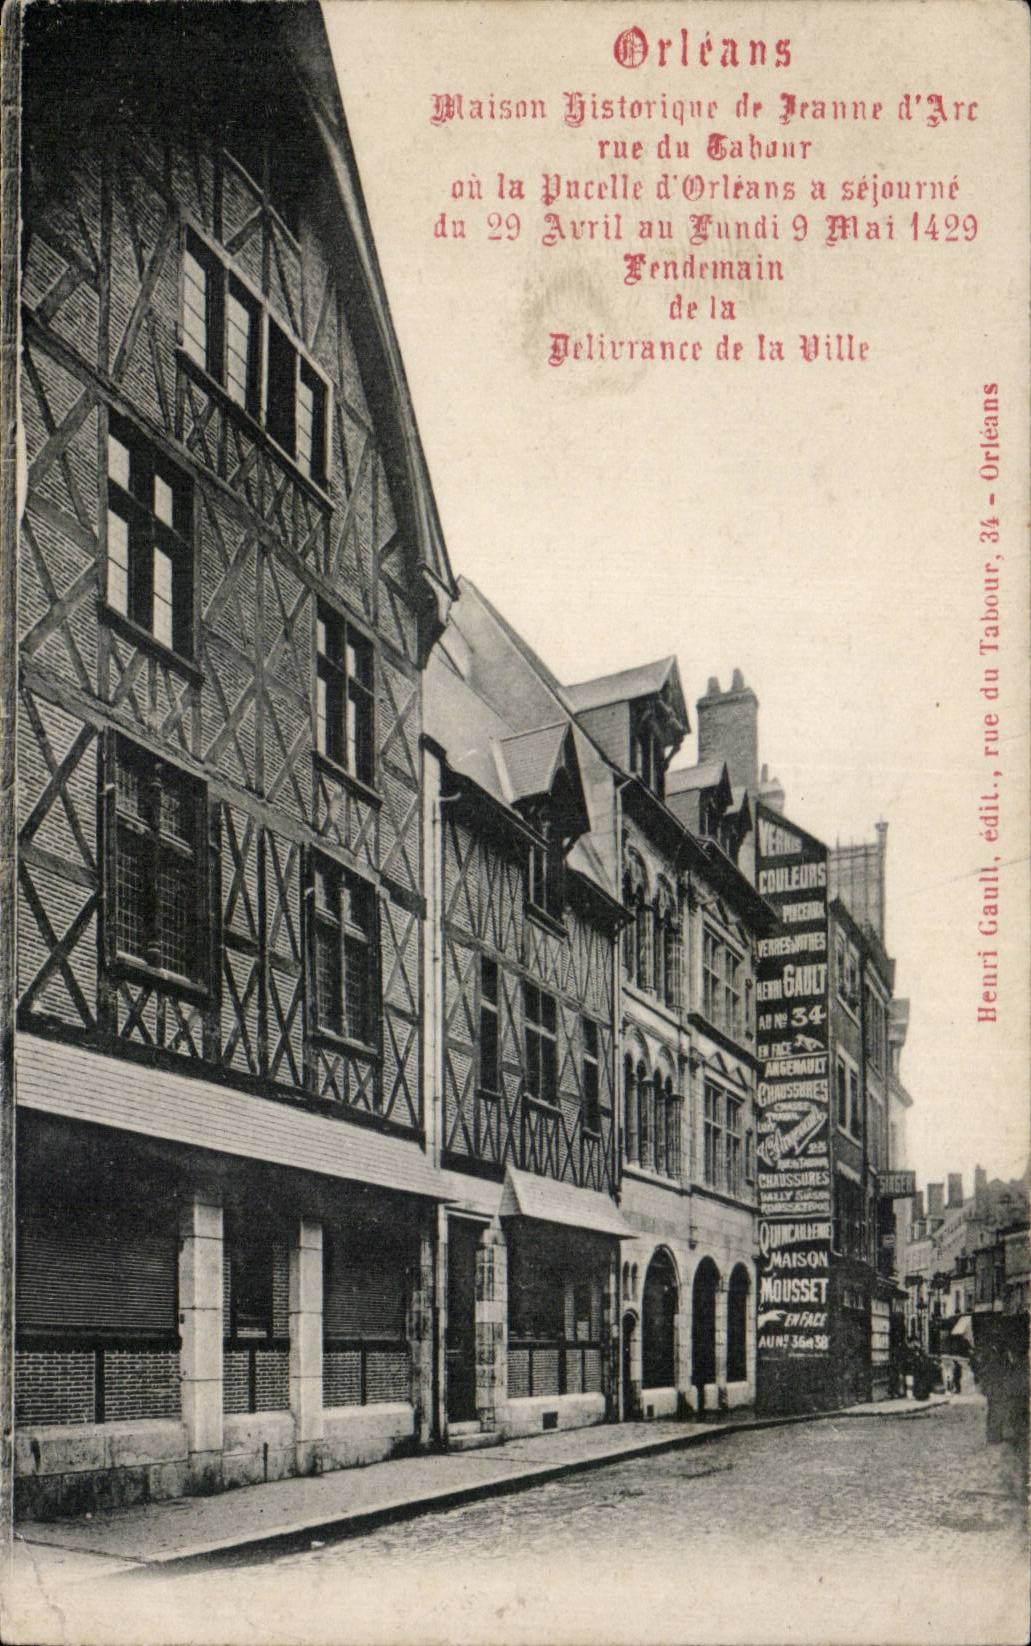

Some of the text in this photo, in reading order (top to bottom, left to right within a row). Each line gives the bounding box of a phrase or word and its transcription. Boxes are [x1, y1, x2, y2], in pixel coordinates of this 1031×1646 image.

[759, 862, 827, 894] COULEURS
[756, 964, 828, 1001] HENRI GAULT
[791, 1005, 827, 1027] 34
[757, 1078, 829, 1108] CHAUSSURES
[758, 1172, 831, 1189] CHAUSSURES
[764, 1250, 830, 1272] MAISON
[760, 1276, 830, 1305] MOUSSET
[784, 1311, 828, 1328] EN FACE
[758, 1334, 775, 1349] AU
